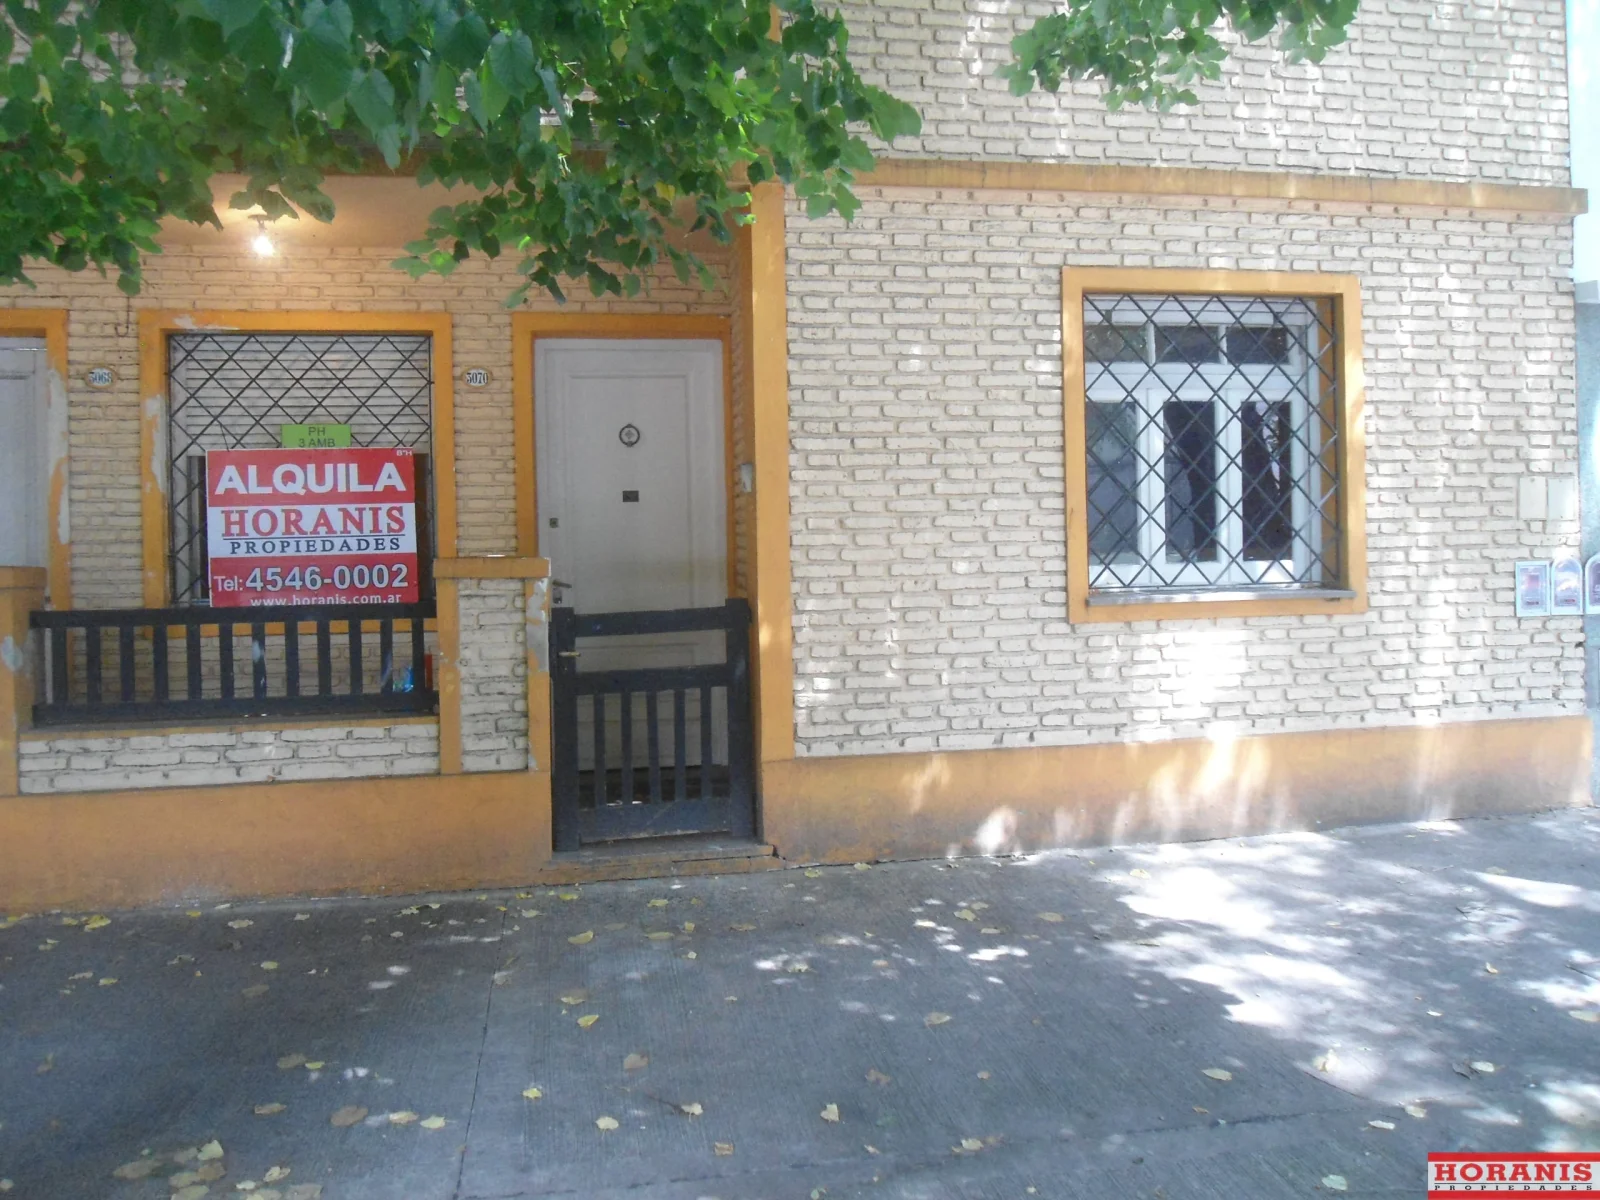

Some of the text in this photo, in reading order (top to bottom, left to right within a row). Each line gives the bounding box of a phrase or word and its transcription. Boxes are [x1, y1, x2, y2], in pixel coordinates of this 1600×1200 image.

[308, 426, 326, 436] PH
[298, 438, 336, 447] 3 AMB
[214, 462, 407, 496] ALQUILA
[220, 505, 406, 538] HORANIS
[229, 537, 400, 555] PROPIEDADES
[213, 563, 409, 592] Tel: 4546-0002
[249, 593, 402, 607] www.horanis.com.ar
